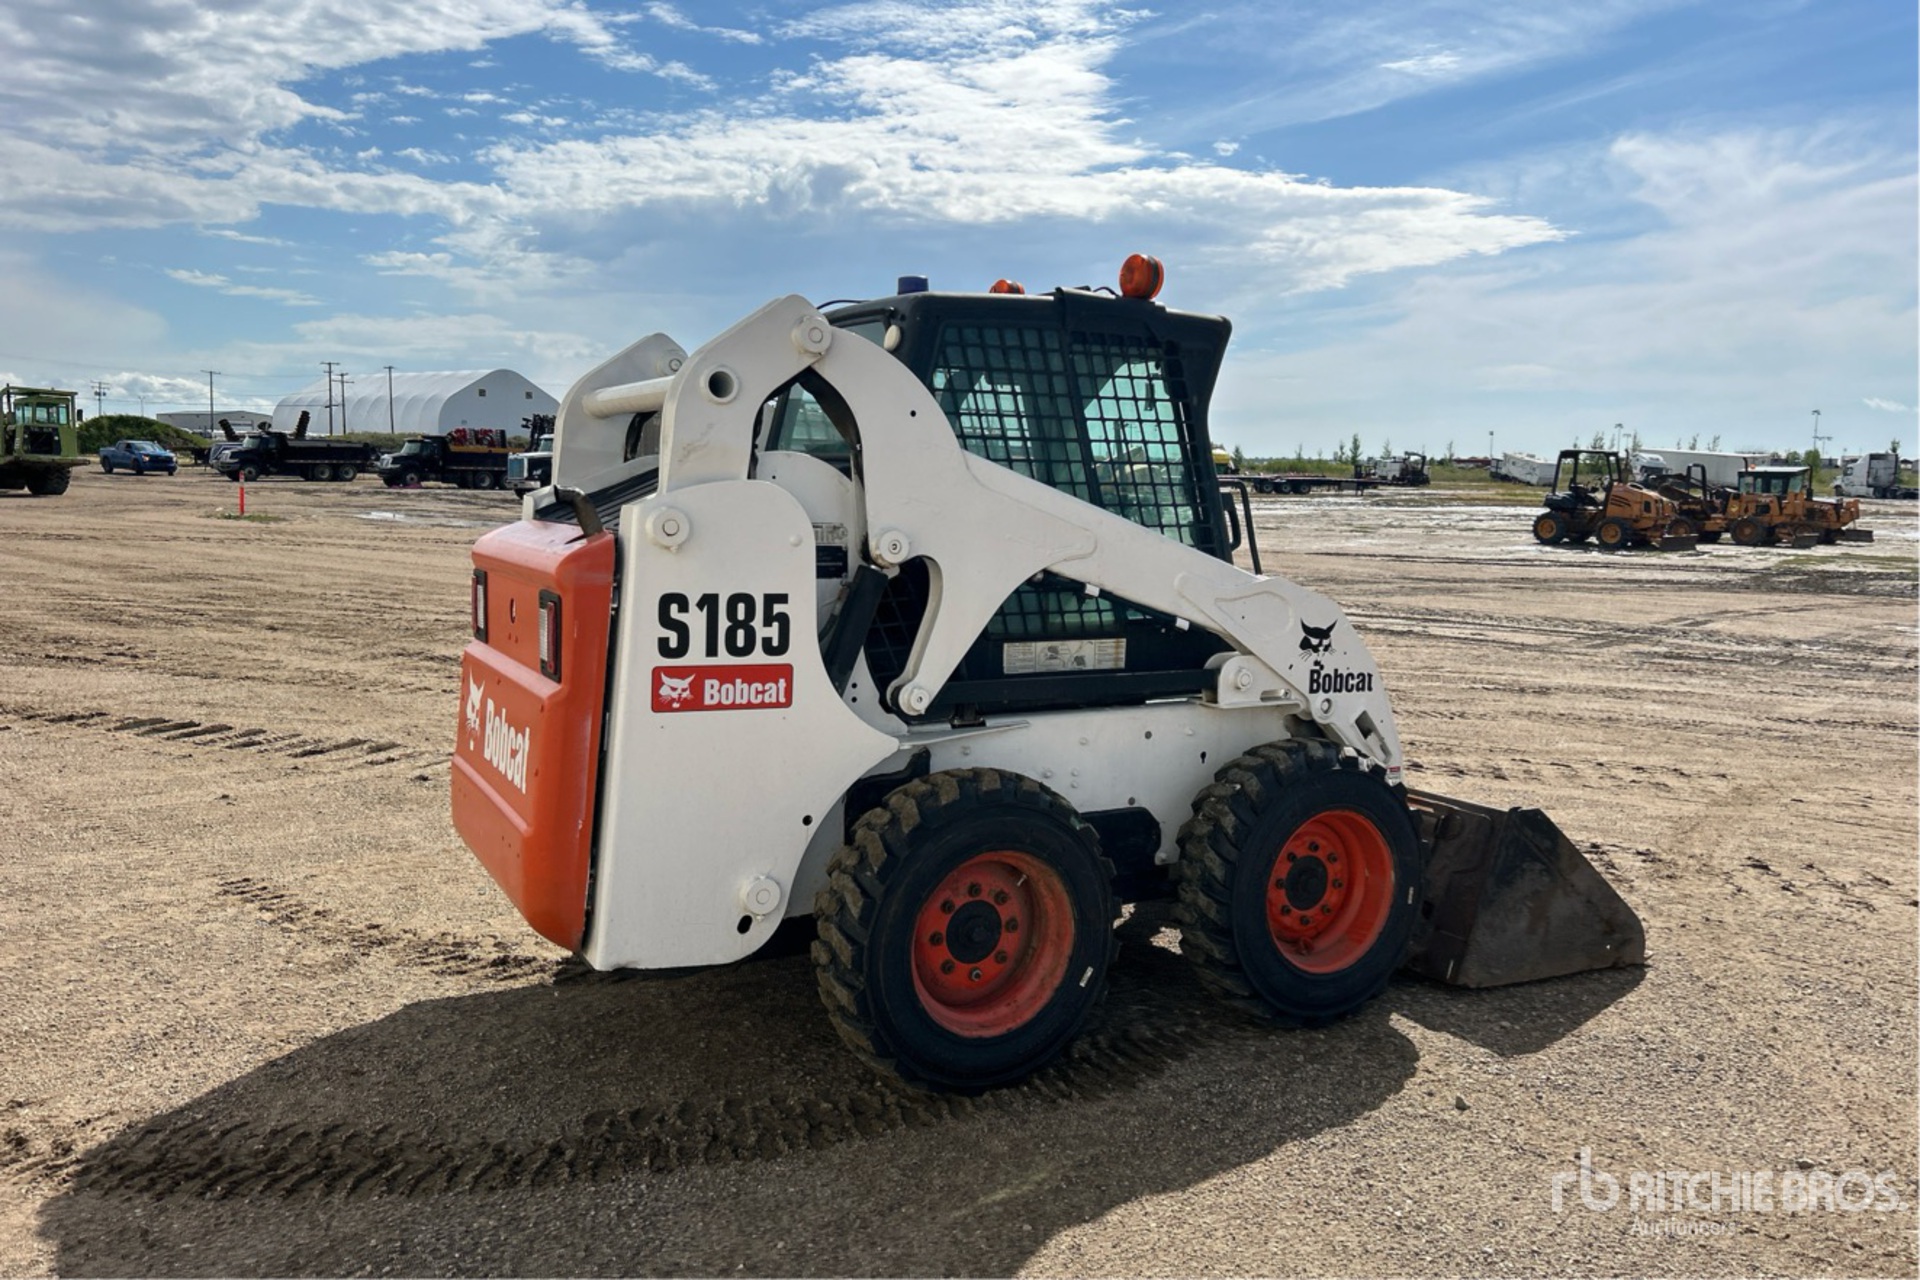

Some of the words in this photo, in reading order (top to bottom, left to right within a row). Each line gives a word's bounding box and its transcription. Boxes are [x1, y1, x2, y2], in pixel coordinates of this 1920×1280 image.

[656, 592, 790, 660] S185
[703, 678, 787, 706] Bobcat
[1308, 668, 1374, 695] Bobcat
[483, 698, 531, 795] Bobcat
